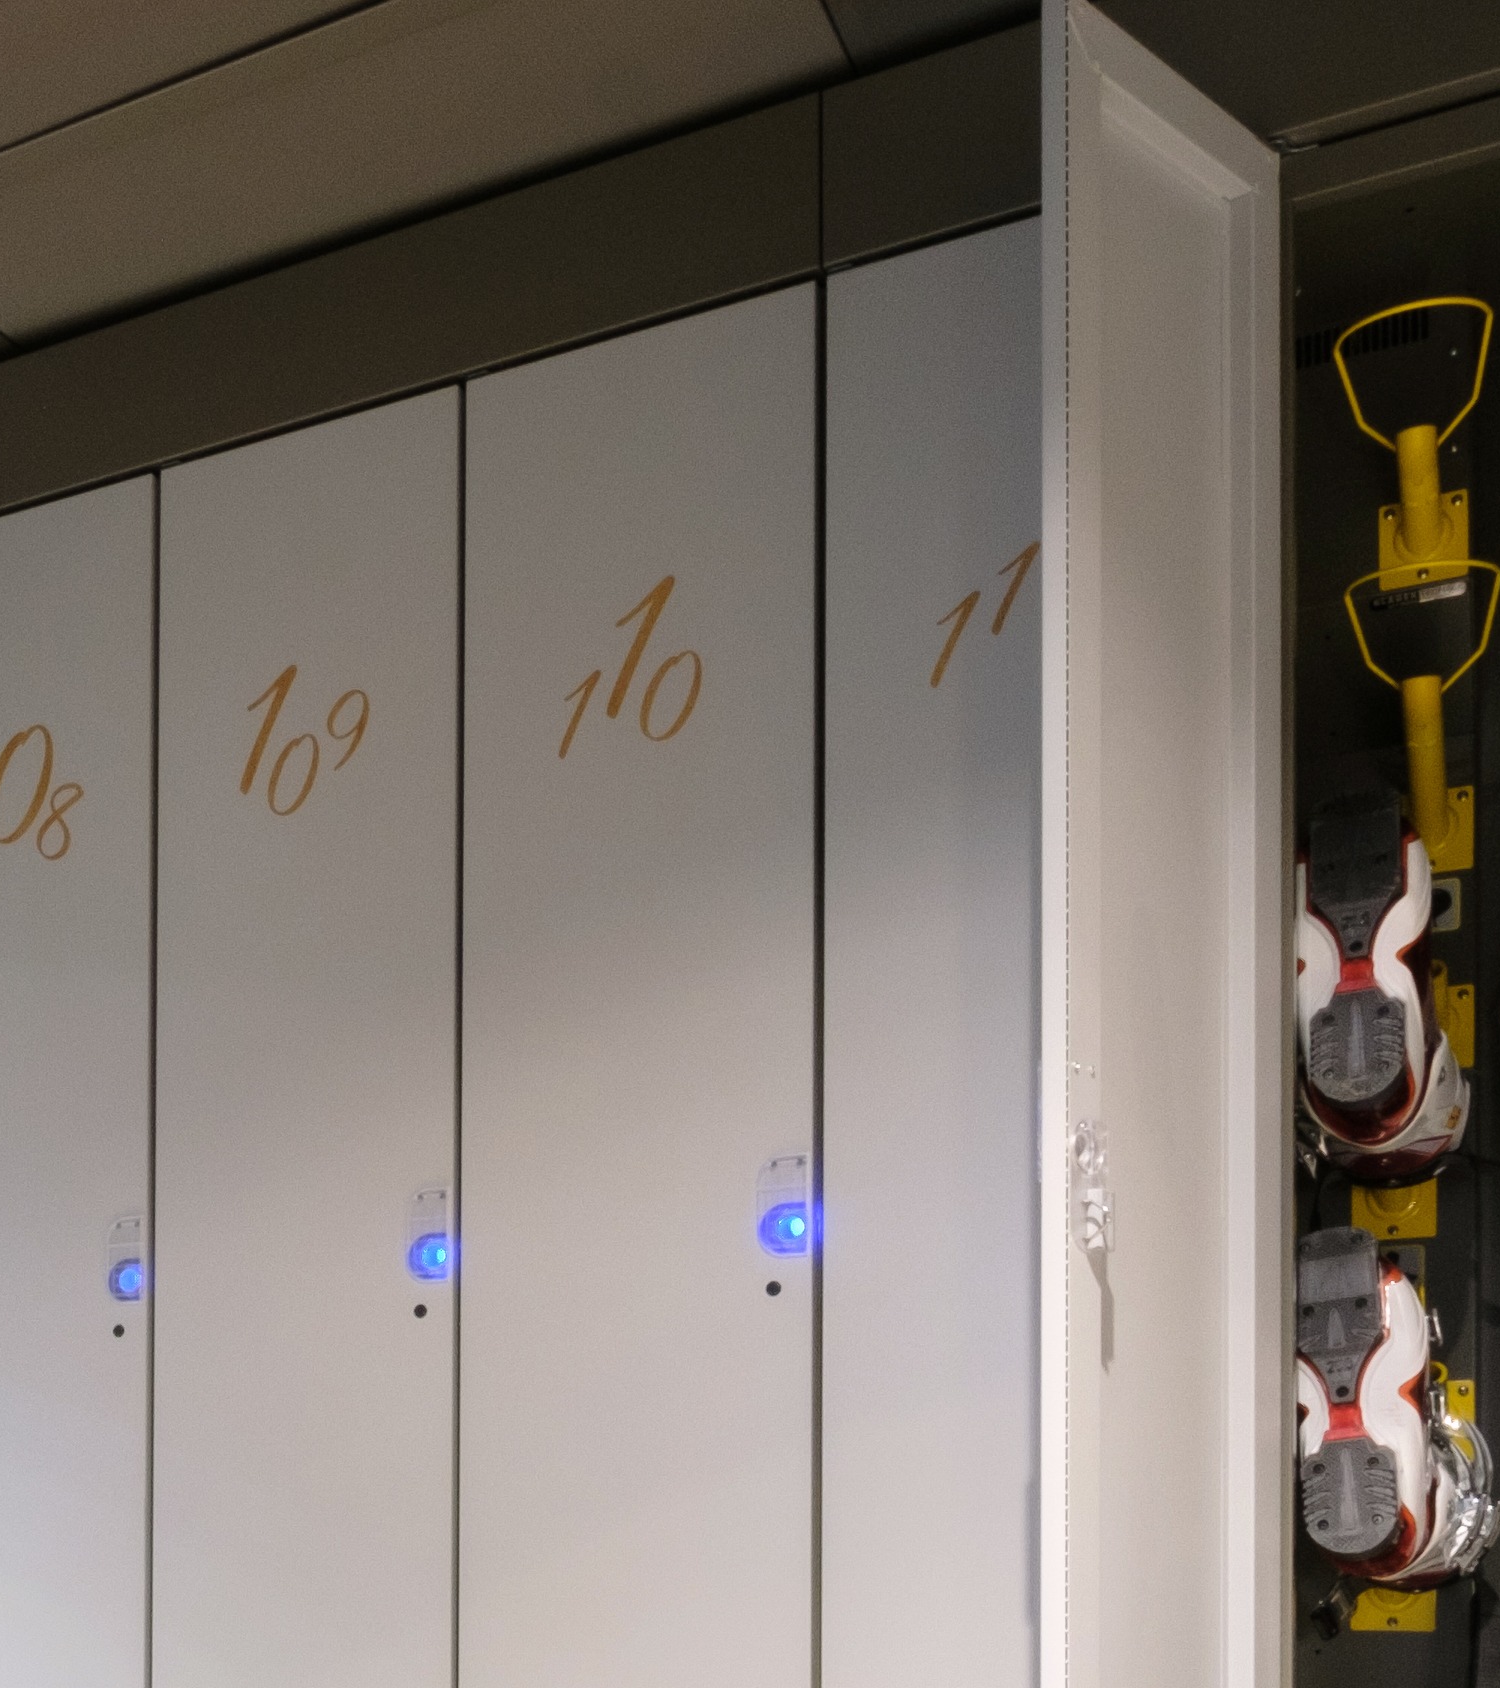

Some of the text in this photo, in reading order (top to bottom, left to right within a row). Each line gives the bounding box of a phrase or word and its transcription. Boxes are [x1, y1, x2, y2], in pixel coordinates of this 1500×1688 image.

[557, 575, 703, 760] 110
[930, 540, 1042, 688] 11
[239, 664, 371, 817] 109
